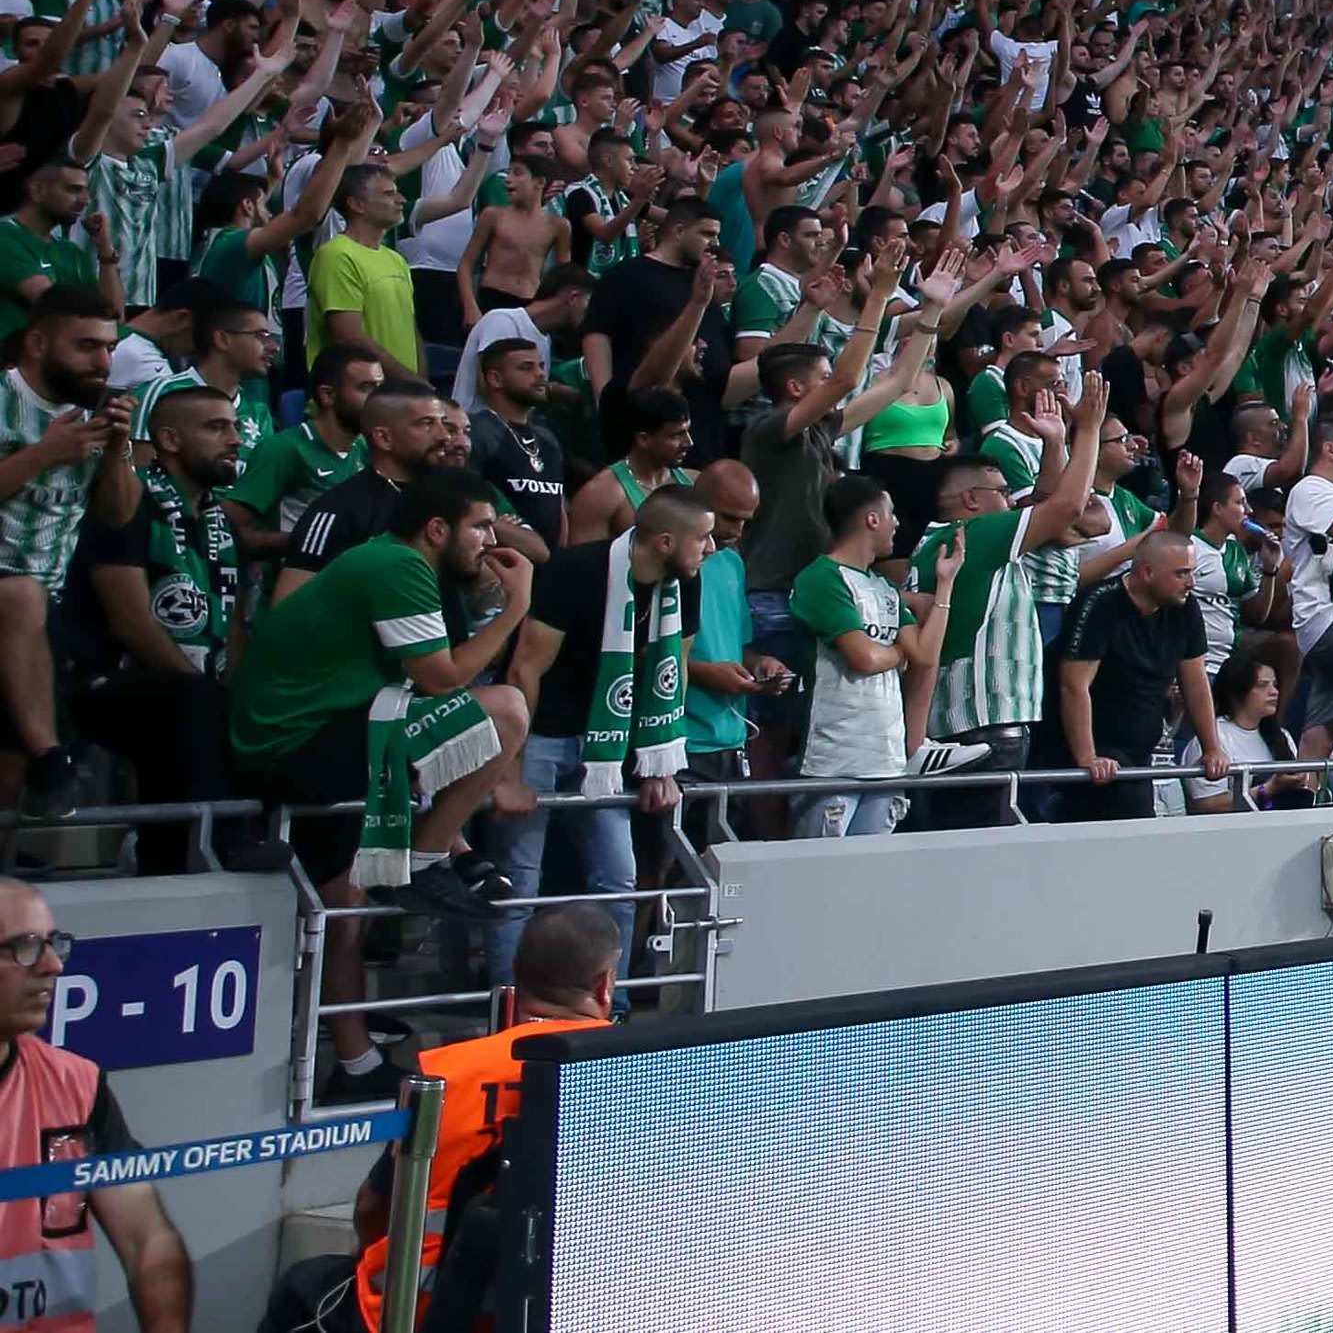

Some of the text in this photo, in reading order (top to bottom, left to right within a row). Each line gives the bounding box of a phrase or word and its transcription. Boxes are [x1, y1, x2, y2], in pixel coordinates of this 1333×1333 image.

[52, 974, 99, 1047] P
[173, 959, 249, 1034] 10
[73, 1121, 373, 1187] SAMMY OFER STADIUM
